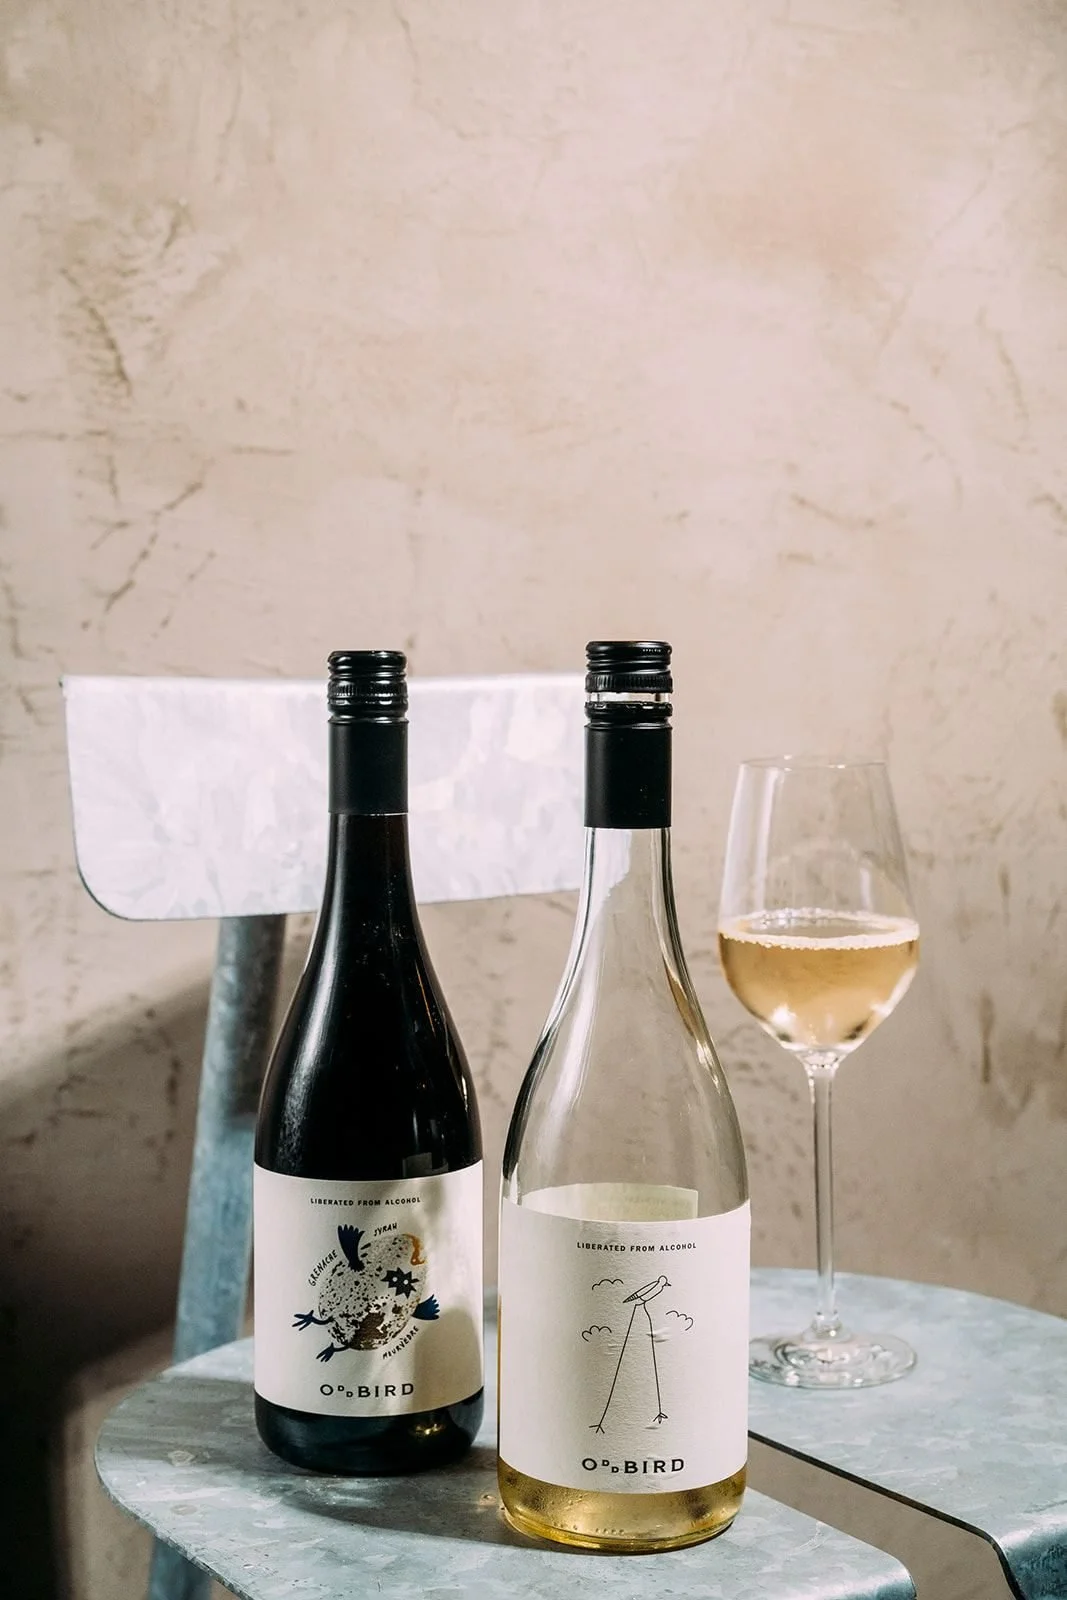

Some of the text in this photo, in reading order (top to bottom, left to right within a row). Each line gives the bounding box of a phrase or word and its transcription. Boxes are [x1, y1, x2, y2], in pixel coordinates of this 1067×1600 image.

[310, 1197, 354, 1206] LIBERATED
[384, 1197, 421, 1205] ALCOHOL
[374, 1222, 398, 1237] SYRAH
[577, 1242, 626, 1252] LIBERATED
[659, 1242, 697, 1252] ALCOHOL
[308, 1250, 338, 1286] GRENACHE
